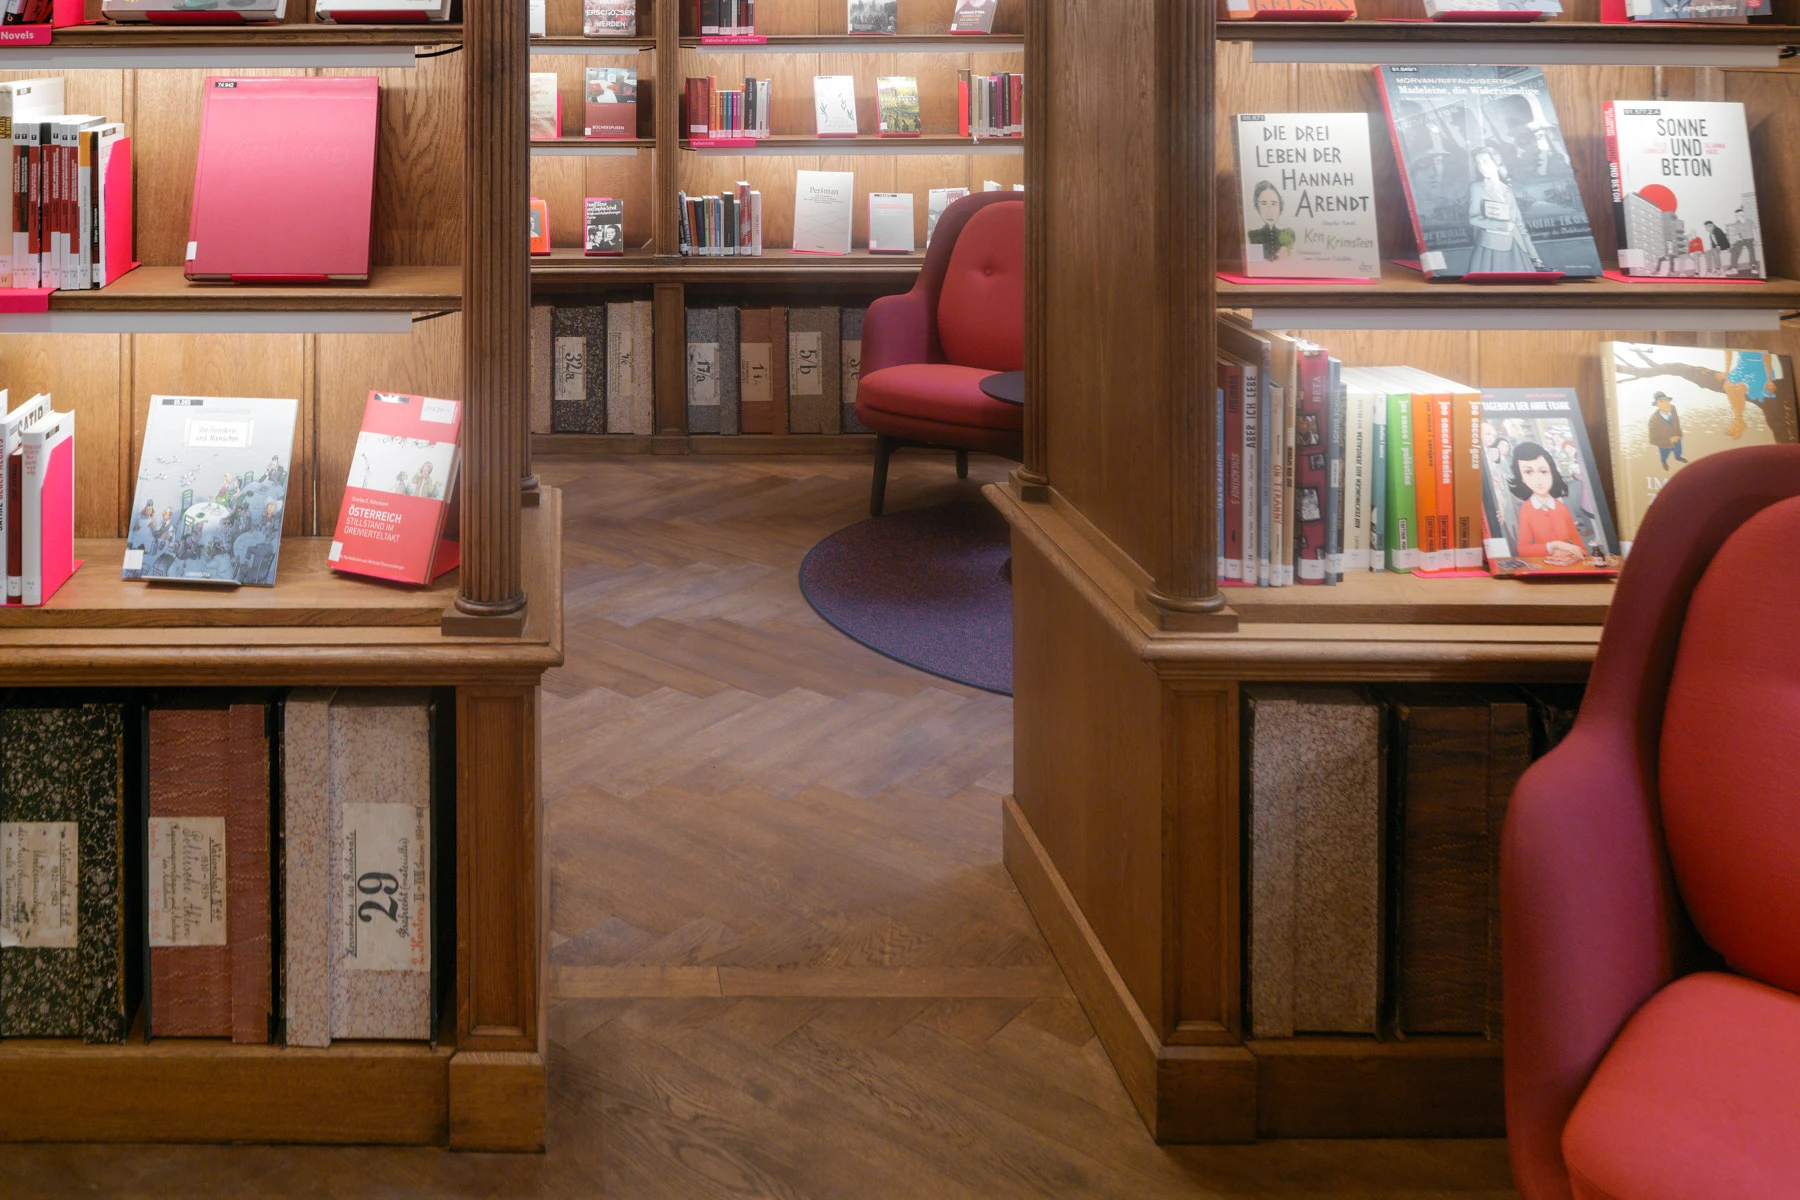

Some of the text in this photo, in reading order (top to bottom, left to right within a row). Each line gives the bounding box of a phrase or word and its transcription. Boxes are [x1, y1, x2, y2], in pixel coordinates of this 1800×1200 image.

[1663, 2, 1679, 13] art
[0, 30, 35, 40] Novels
[1398, 85, 1540, 97] Madeleine, die Widerständige
[1263, 125, 1330, 142] DIE DREI
[1656, 118, 1708, 137] SONNE
[1256, 145, 1342, 167] LEBEN DER
[1670, 138, 1702, 157] UND
[1661, 158, 1713, 177] BETON
[1281, 168, 1354, 191] HANNAH
[1609, 161, 1622, 203] UND BETON
[1295, 189, 1370, 218] ARENDT
[1304, 227, 1374, 250] Ken Krimstein
[564, 352, 583, 382] 32/a
[800, 350, 817, 375] 5/b
[1312, 375, 1321, 403] BETA
[1246, 375, 1257, 448] ABER ICH LEBE
[1398, 400, 1409, 416] joe
[1438, 401, 1450, 416] joe
[1468, 401, 1481, 416] joe
[1482, 400, 1571, 411] TAGEBUCH DER ANNE FRANK
[1401, 417, 1409, 440] sacco
[1356, 431, 1364, 467] JERUSALEM
[1401, 446, 1412, 486] palästina
[1272, 464, 1283, 526] ON TYRANNY
[1354, 481, 1363, 529] AUFZEICHNUNGEN
[345, 517, 395, 532] STILLSTAND IM
[348, 504, 402, 524] ÖSTERREICH
[343, 525, 401, 543] DREIVIERTELTAKT
[182, 828, 204, 893] Politische
[357, 871, 399, 923] 29
